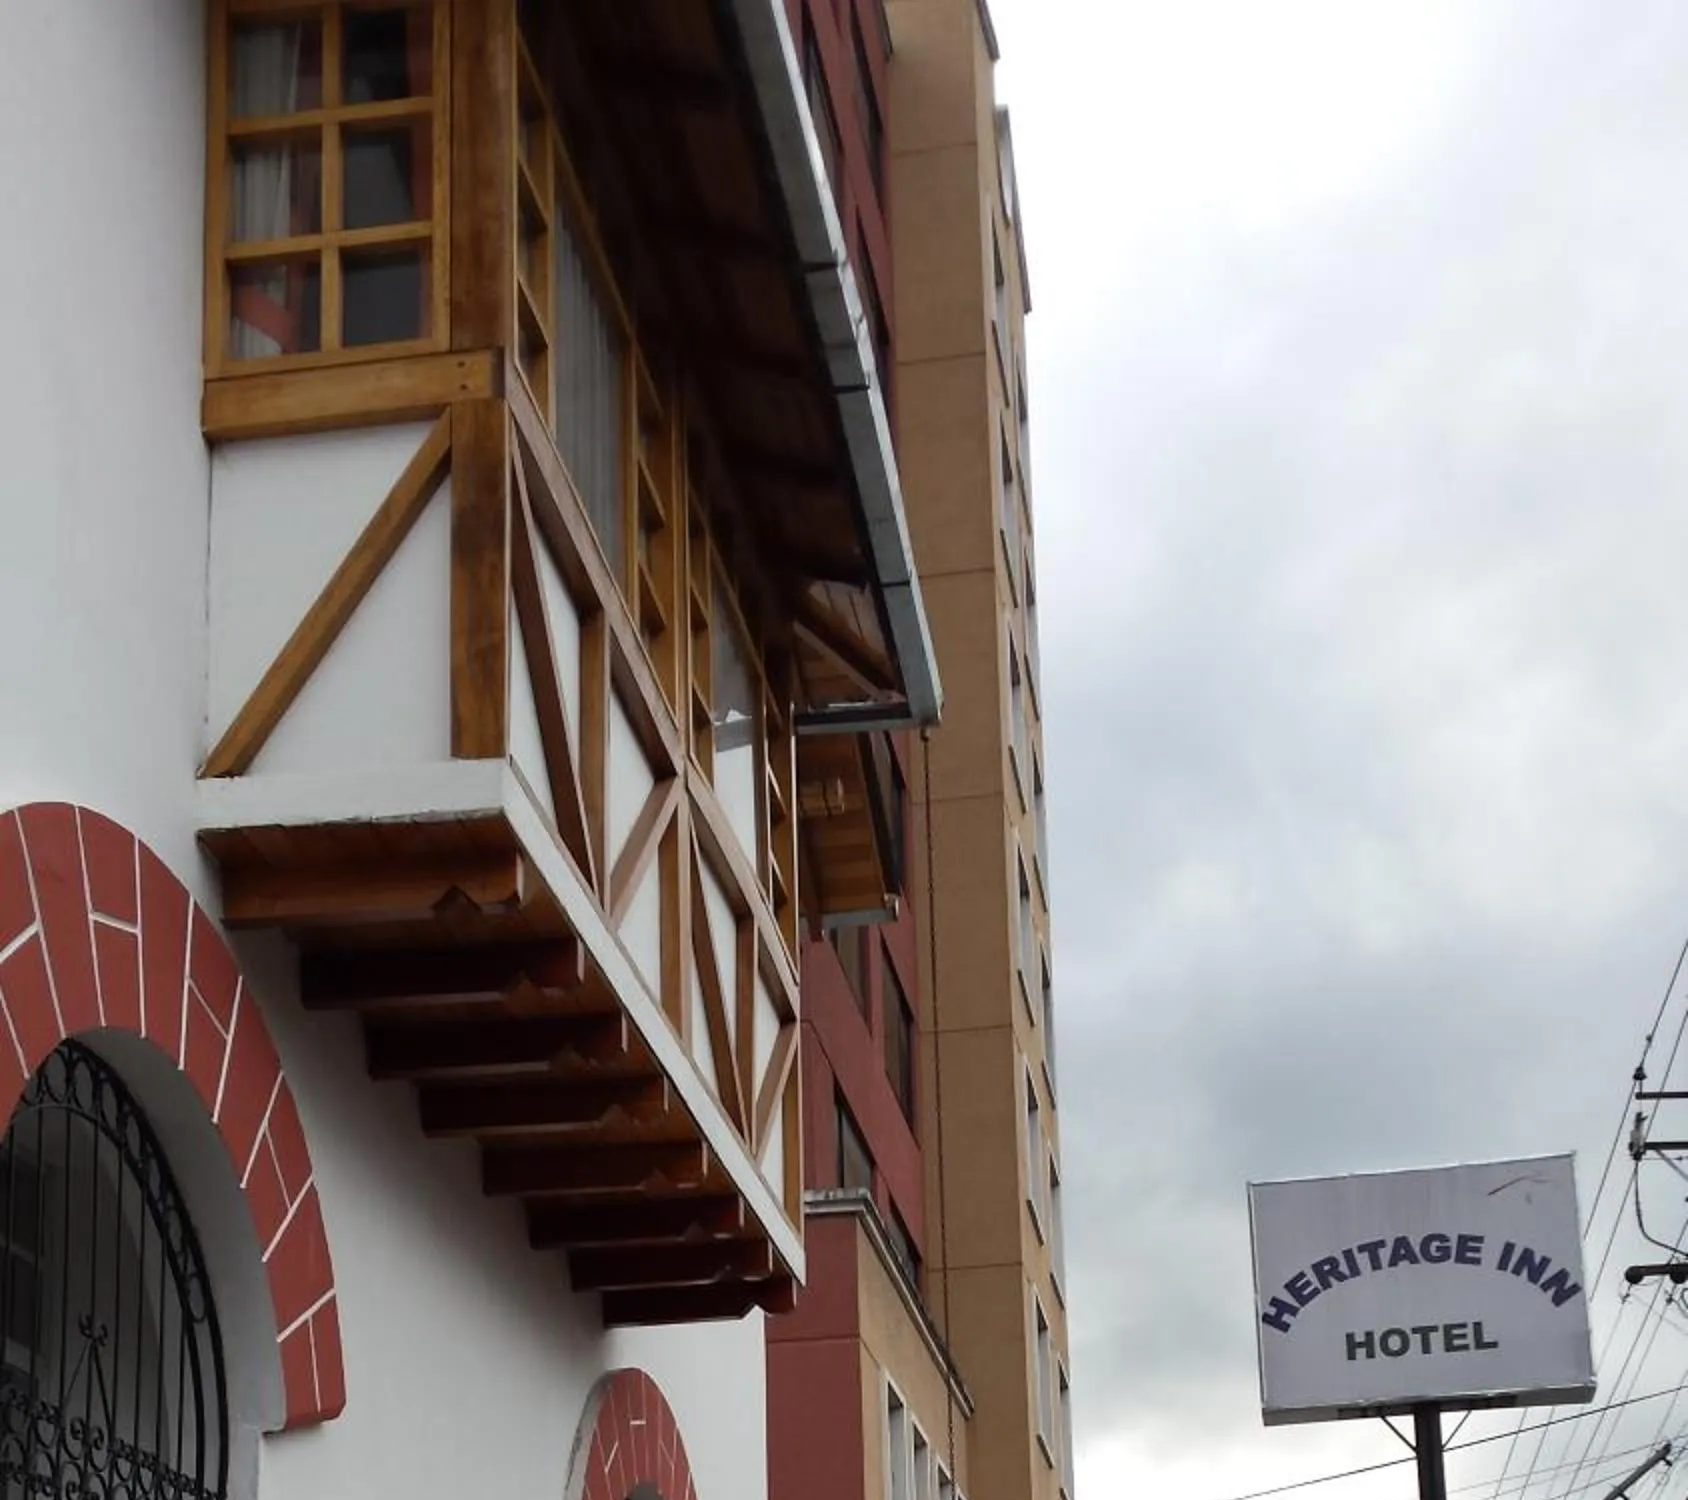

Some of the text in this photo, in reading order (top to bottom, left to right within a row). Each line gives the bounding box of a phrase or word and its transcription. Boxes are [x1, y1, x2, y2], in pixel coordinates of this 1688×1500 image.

[1262, 1233, 1582, 1333] HERITAGE INN
[1346, 1321, 1498, 1360] HOTEL
